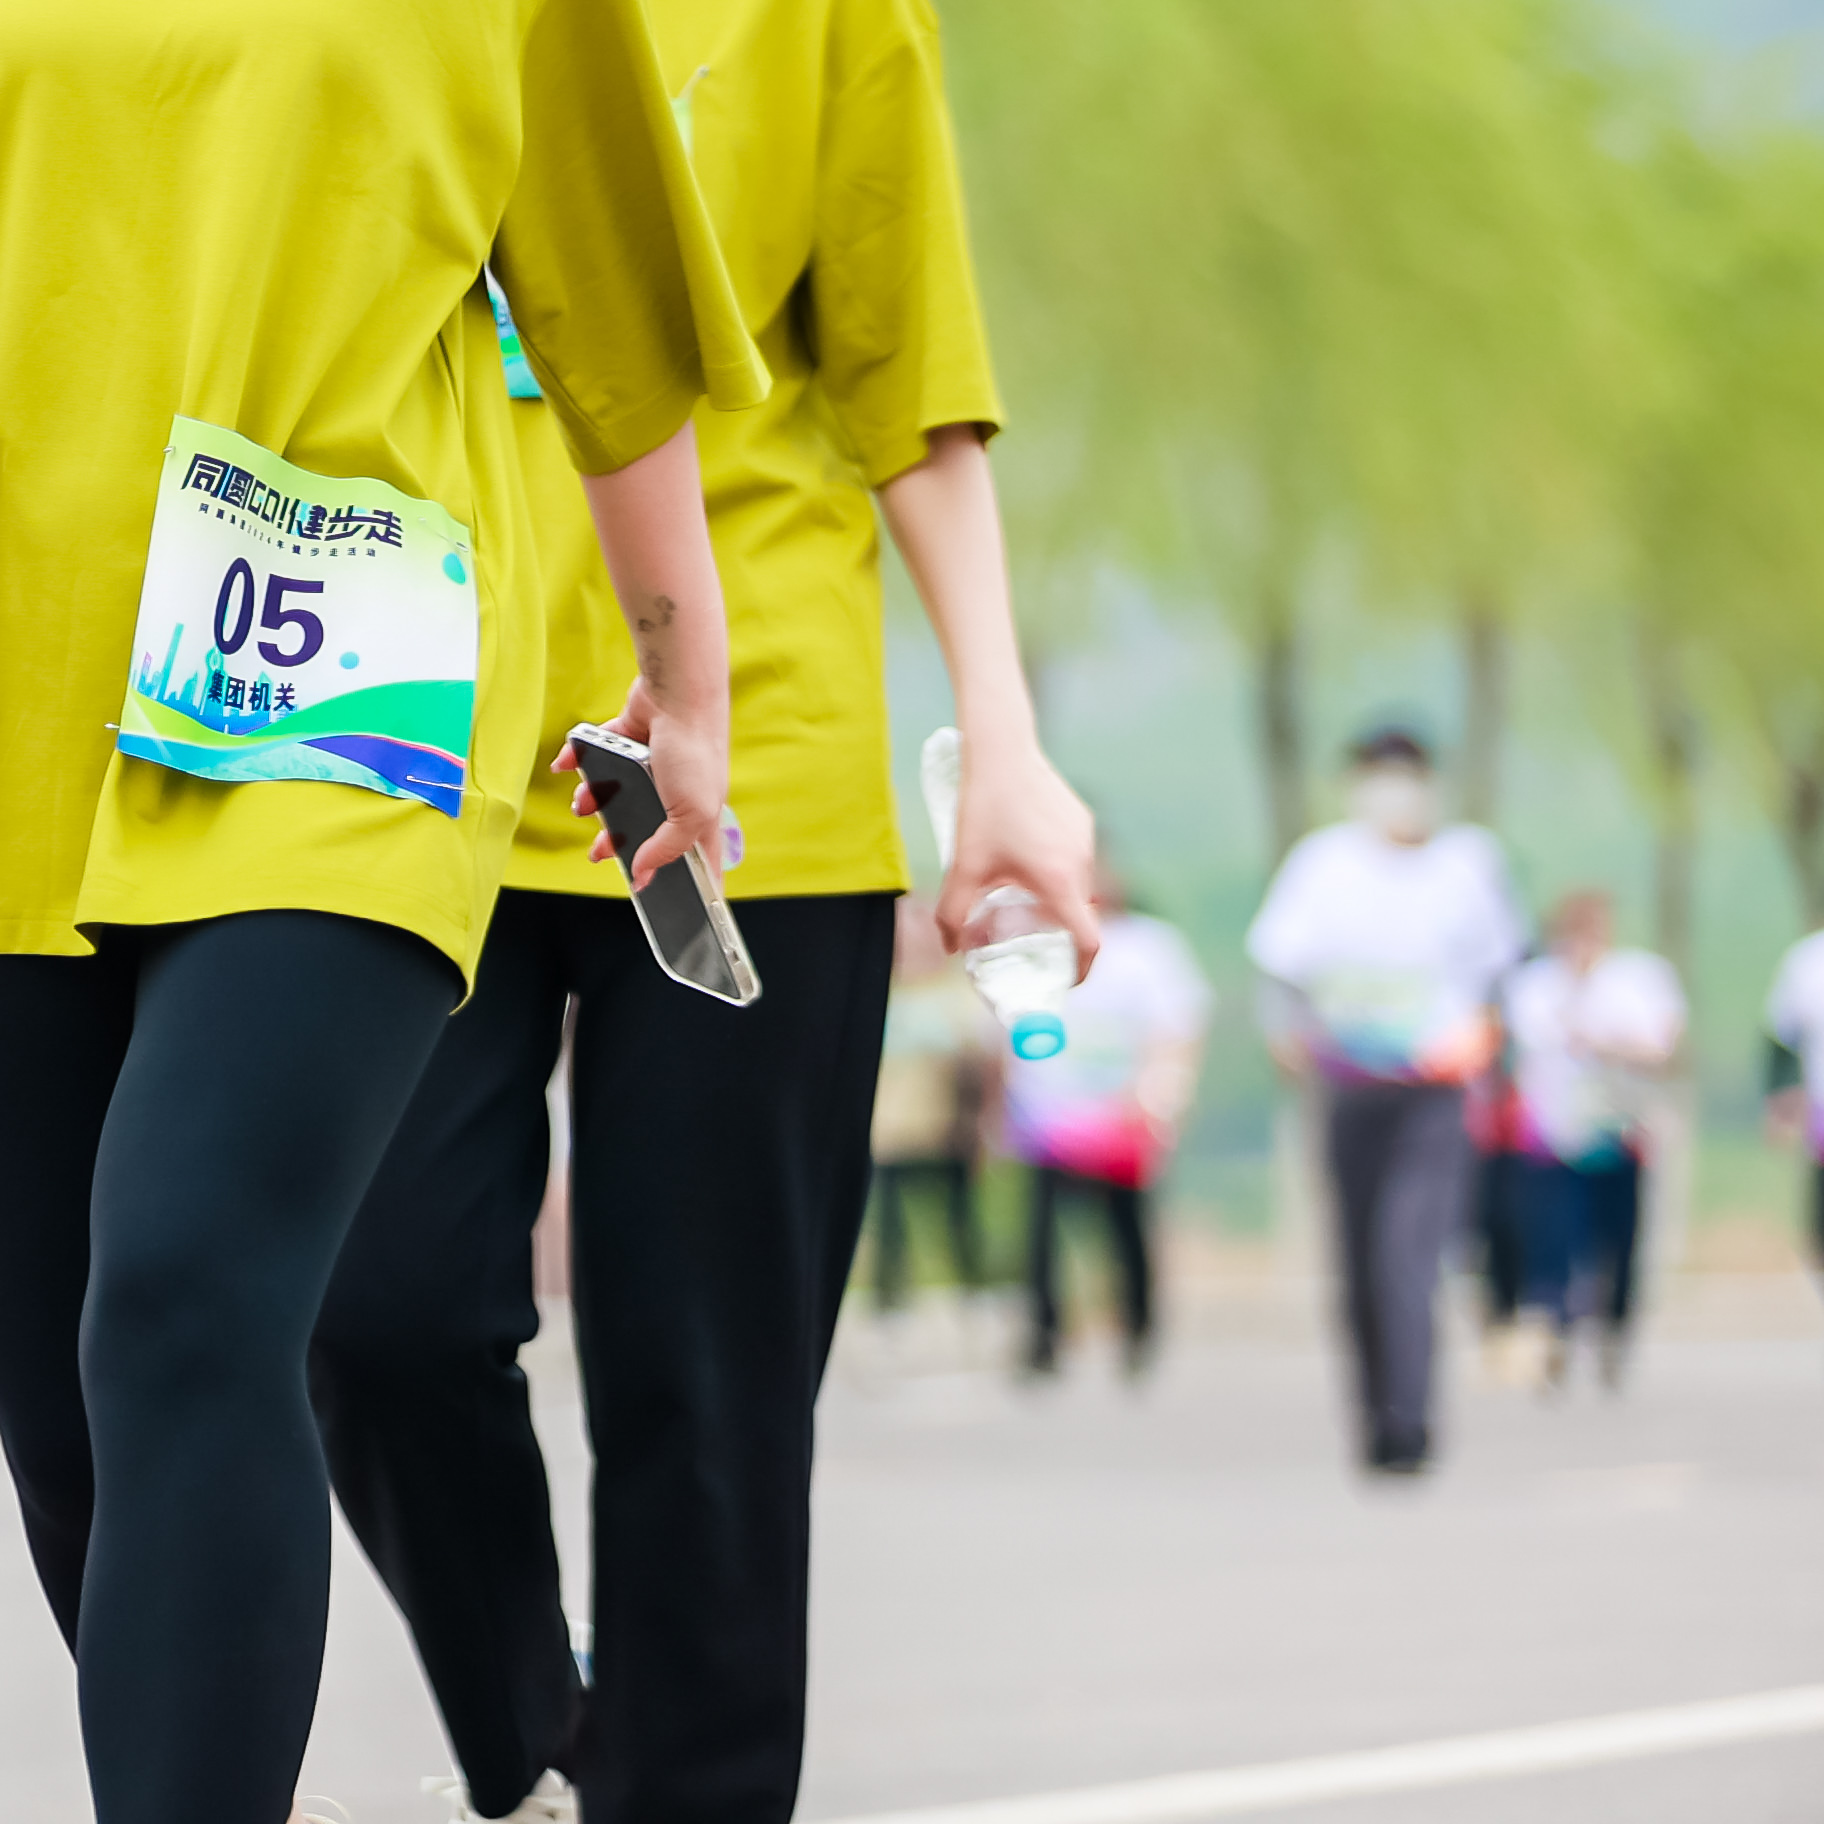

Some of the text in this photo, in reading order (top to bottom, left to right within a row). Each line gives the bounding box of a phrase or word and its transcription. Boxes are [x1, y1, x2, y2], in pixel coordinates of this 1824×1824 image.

[213, 557, 325, 667] 05
[207, 671, 296, 712] 集团机关
